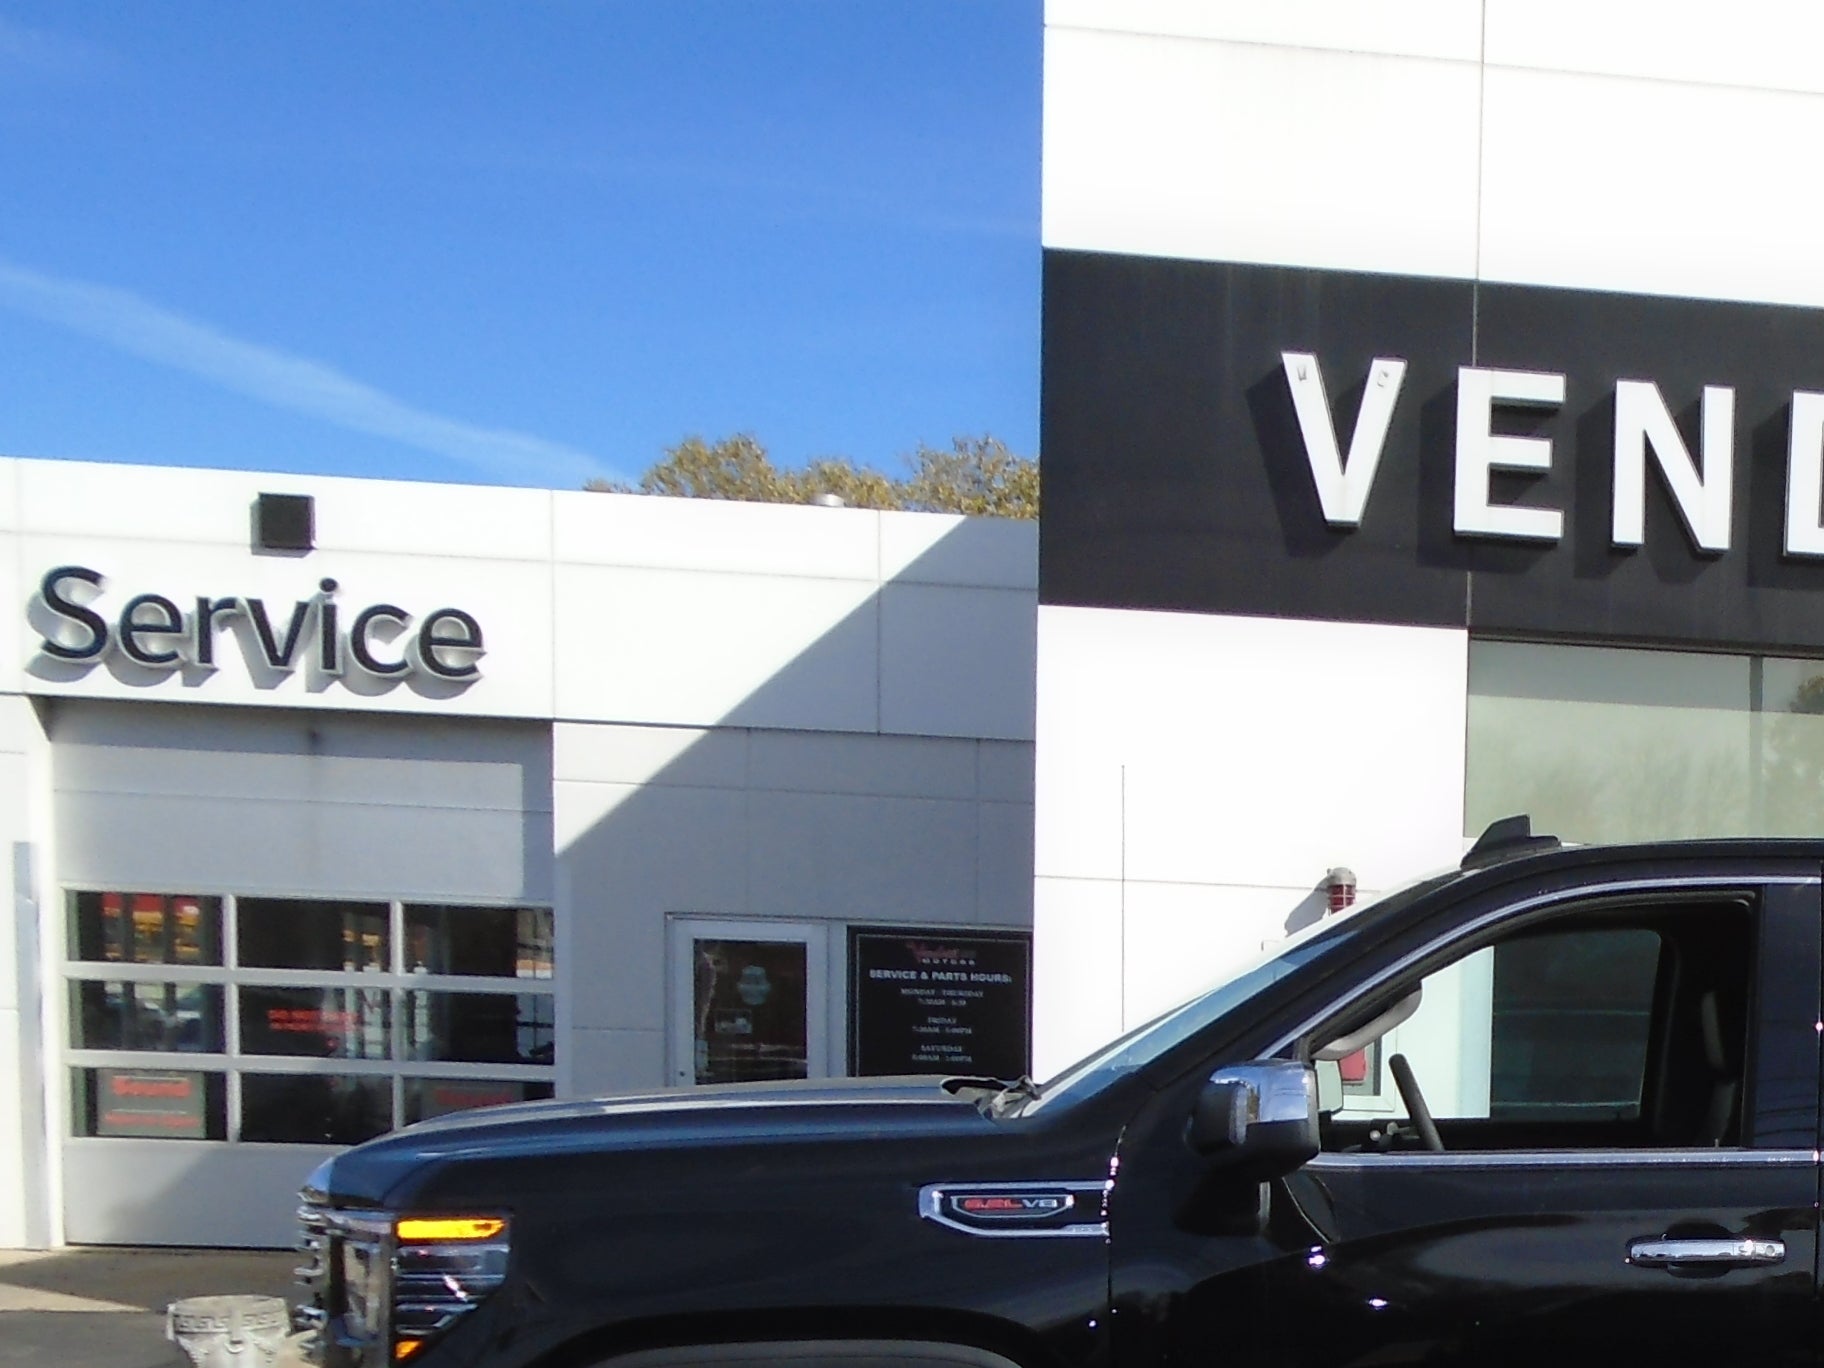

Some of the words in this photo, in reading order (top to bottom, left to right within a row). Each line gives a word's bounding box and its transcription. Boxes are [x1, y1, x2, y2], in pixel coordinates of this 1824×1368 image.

[38, 564, 486, 679] Service
[869, 969, 917, 980] SERVICE
[920, 970, 929, 980] &
[932, 971, 967, 981] PARTS
[970, 972, 1012, 983] HOURS:
